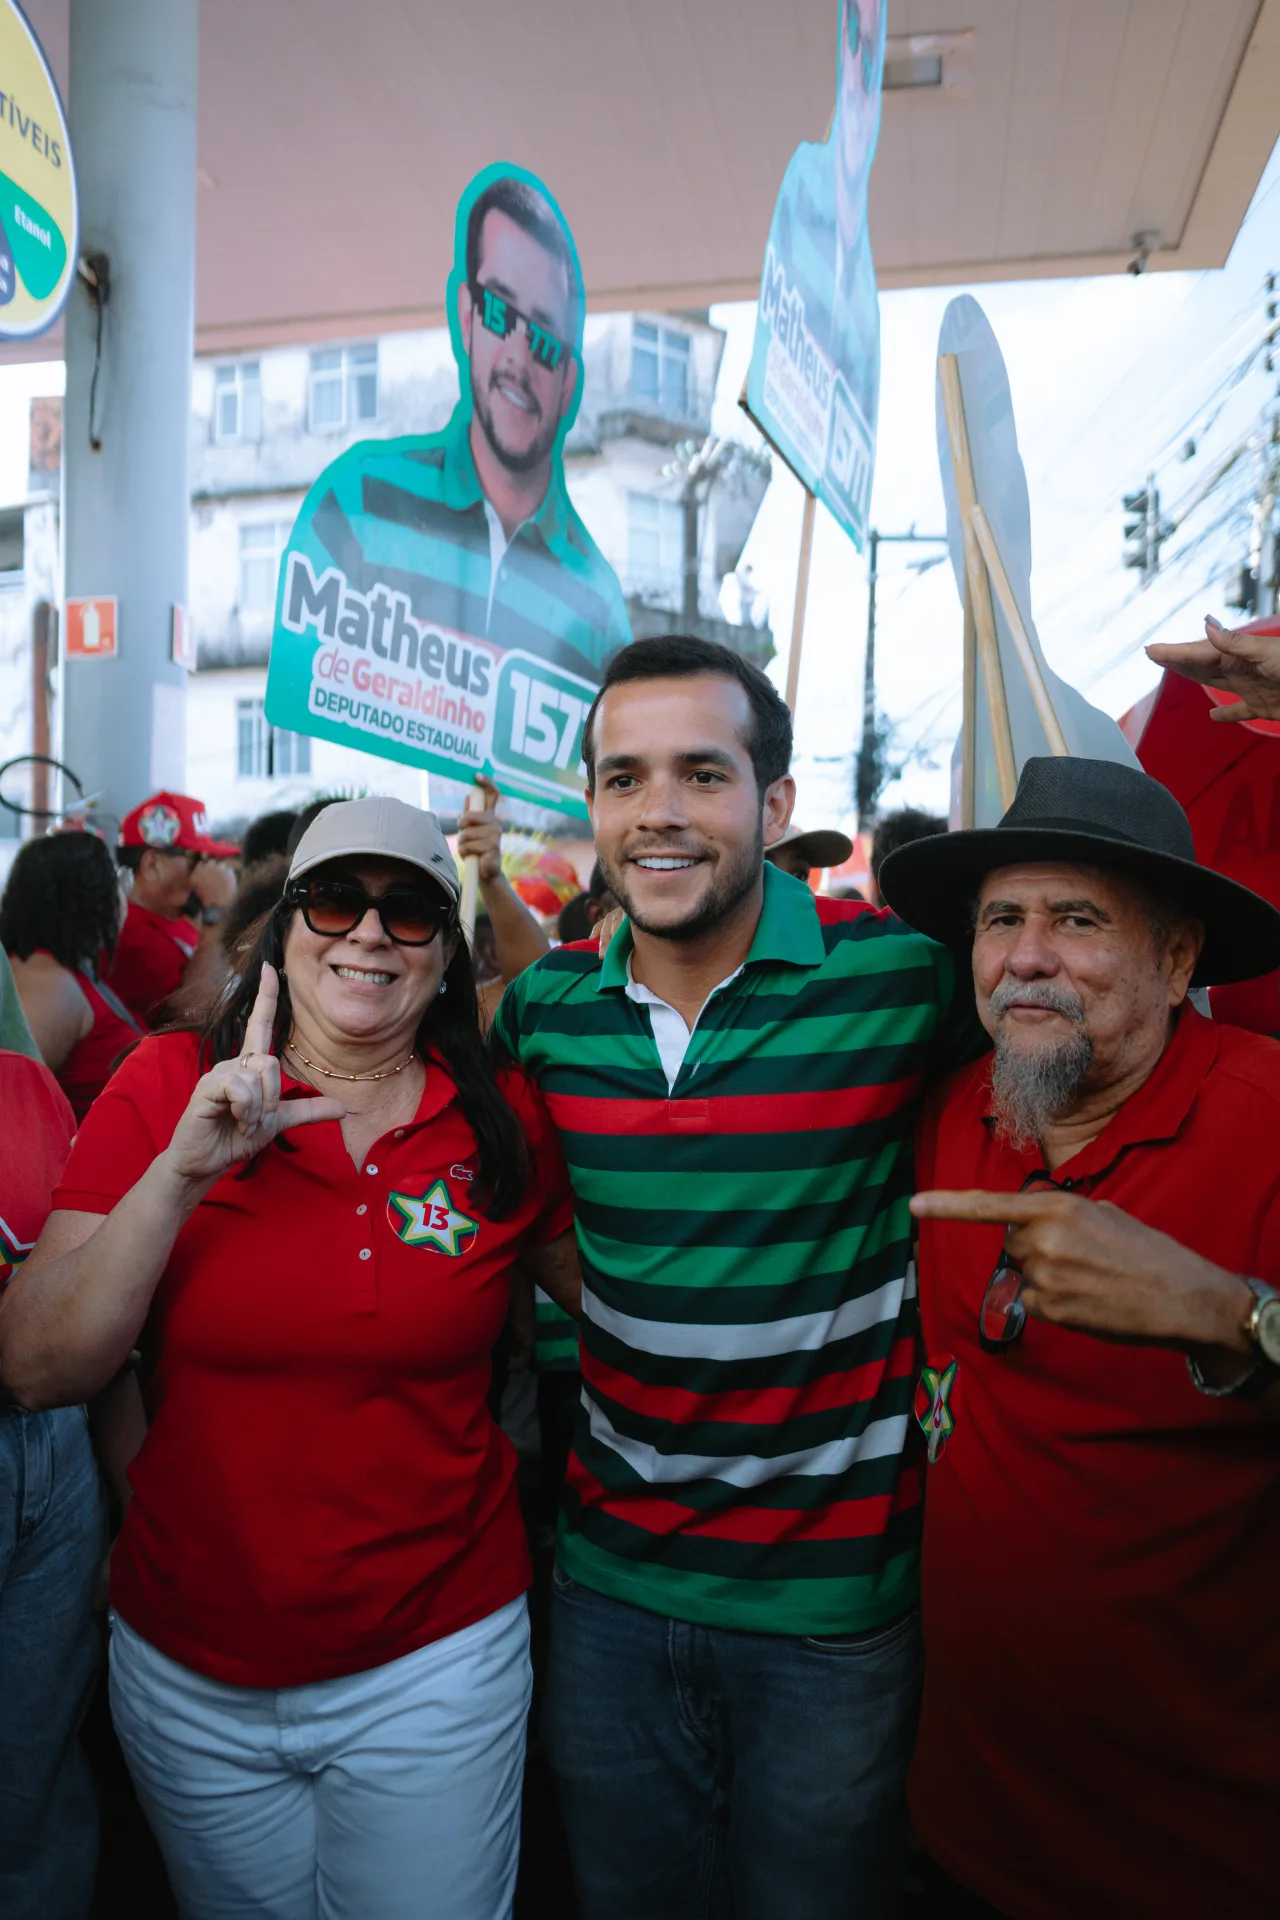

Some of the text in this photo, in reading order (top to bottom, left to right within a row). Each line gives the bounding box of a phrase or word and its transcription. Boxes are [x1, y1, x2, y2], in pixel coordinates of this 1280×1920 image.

[762, 248, 830, 412] Matheus
[287, 560, 491, 698] Matheus
[314, 688, 481, 761] DEPUTADO ESTADUAL
[317, 647, 486, 733] de Geraldinho
[510, 668, 592, 779] 157
[422, 1203, 450, 1230] 13
